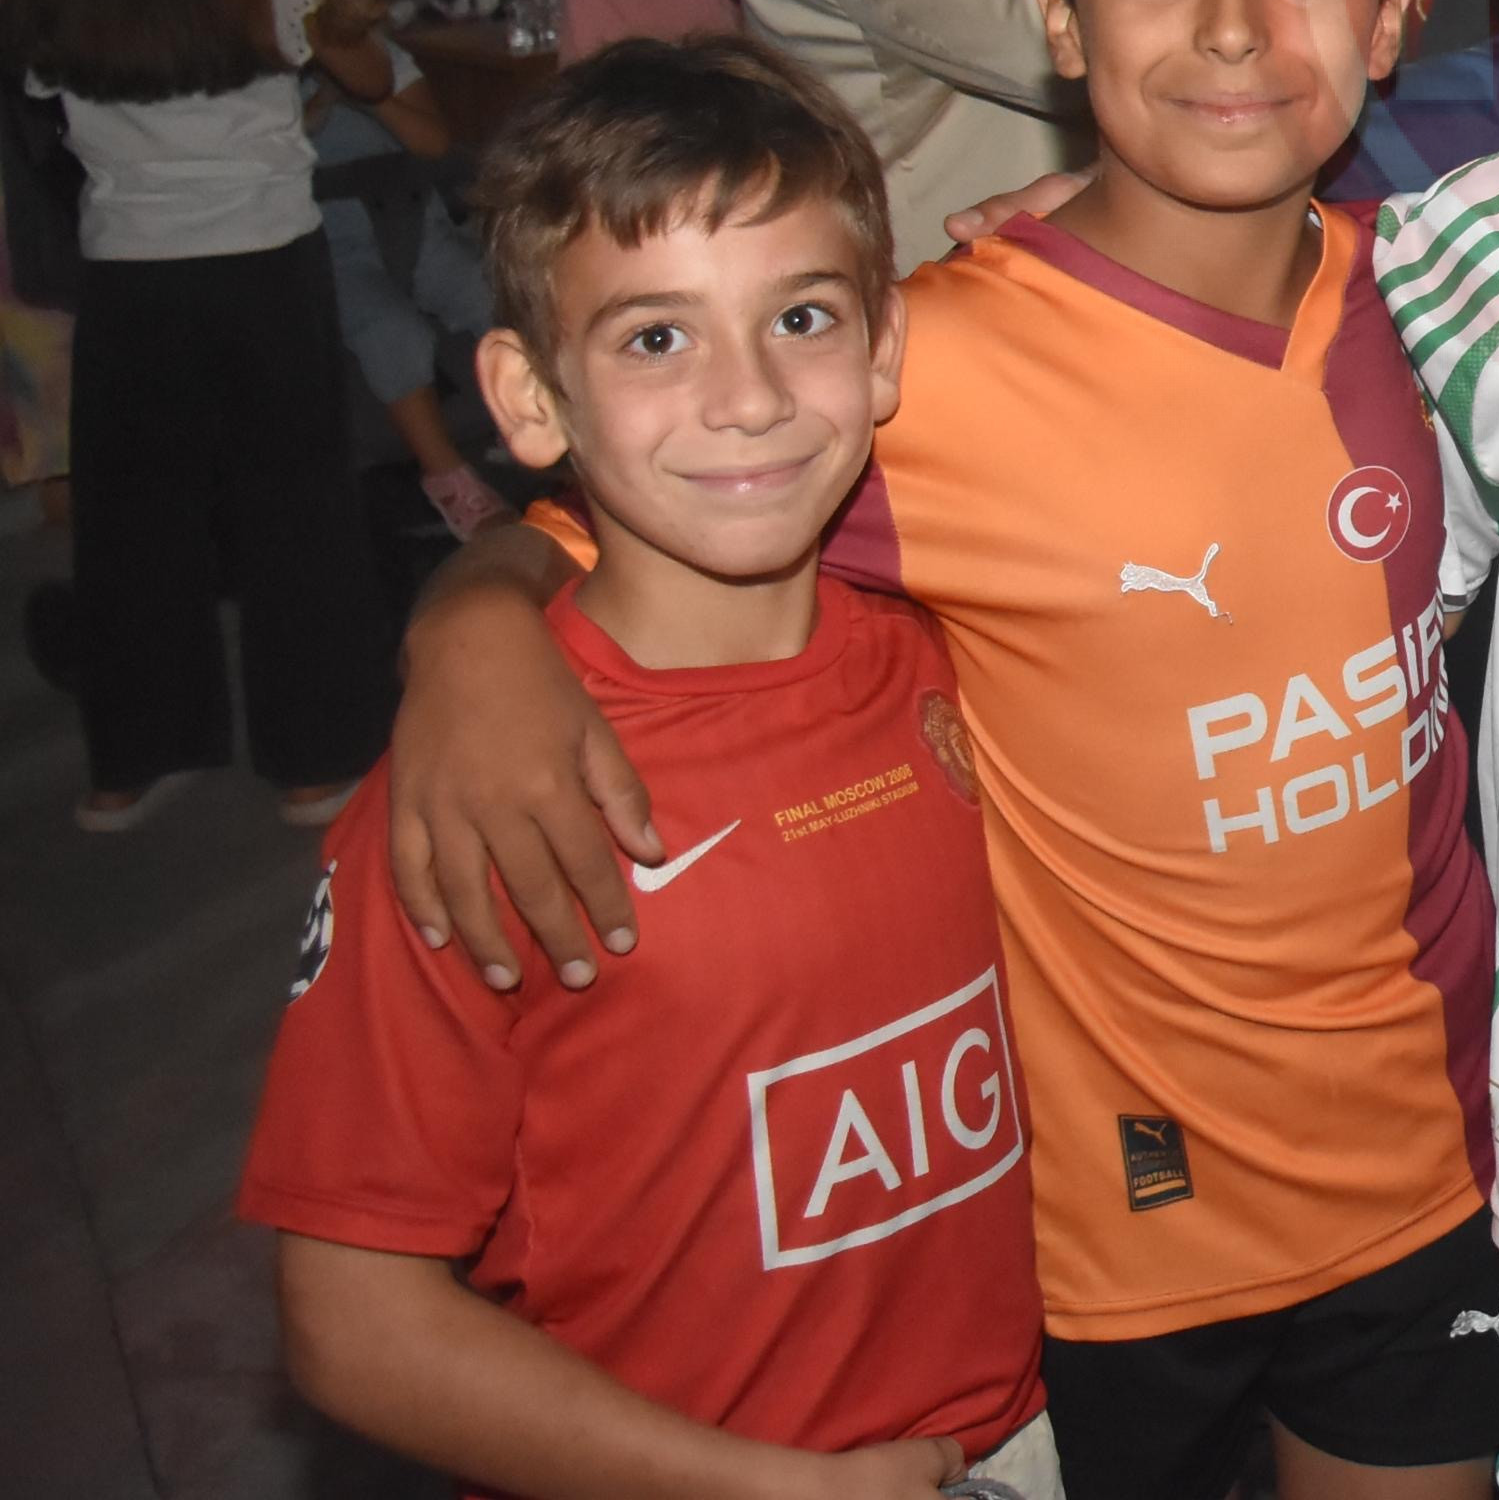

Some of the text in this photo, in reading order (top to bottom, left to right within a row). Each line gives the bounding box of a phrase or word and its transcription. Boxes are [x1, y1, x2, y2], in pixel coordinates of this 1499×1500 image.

[773, 800, 824, 827] FINAL
[822, 774, 887, 810] MOSCOW
[880, 781, 920, 805] STADIUM
[802, 1027, 1003, 1220] AIG
